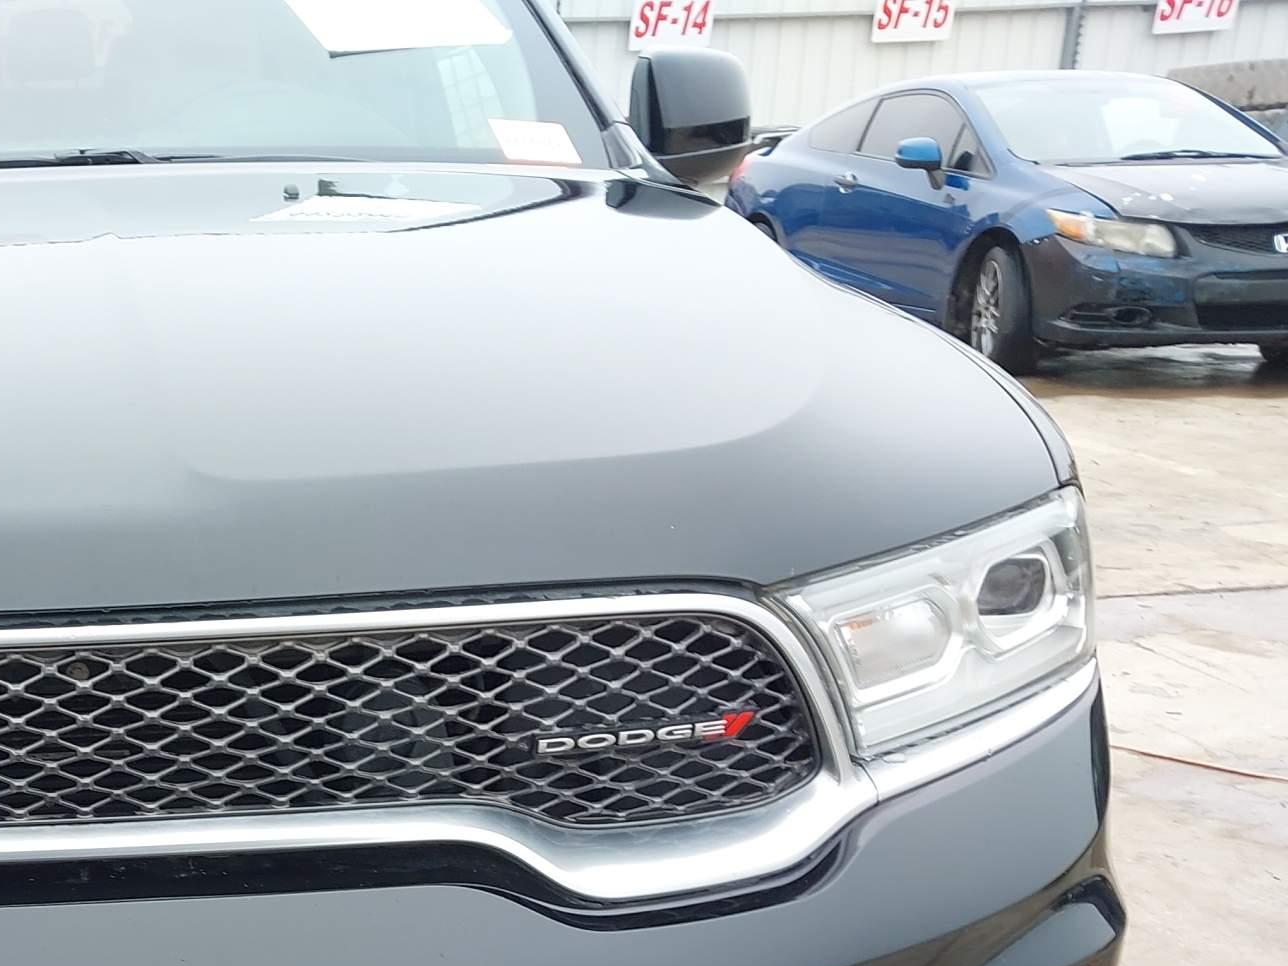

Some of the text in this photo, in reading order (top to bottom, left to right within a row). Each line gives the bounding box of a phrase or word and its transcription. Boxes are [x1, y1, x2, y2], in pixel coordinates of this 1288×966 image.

[634, 0, 711, 38] SF-14
[877, 0, 949, 30] SF-15
[537, 719, 728, 754] DODGE
